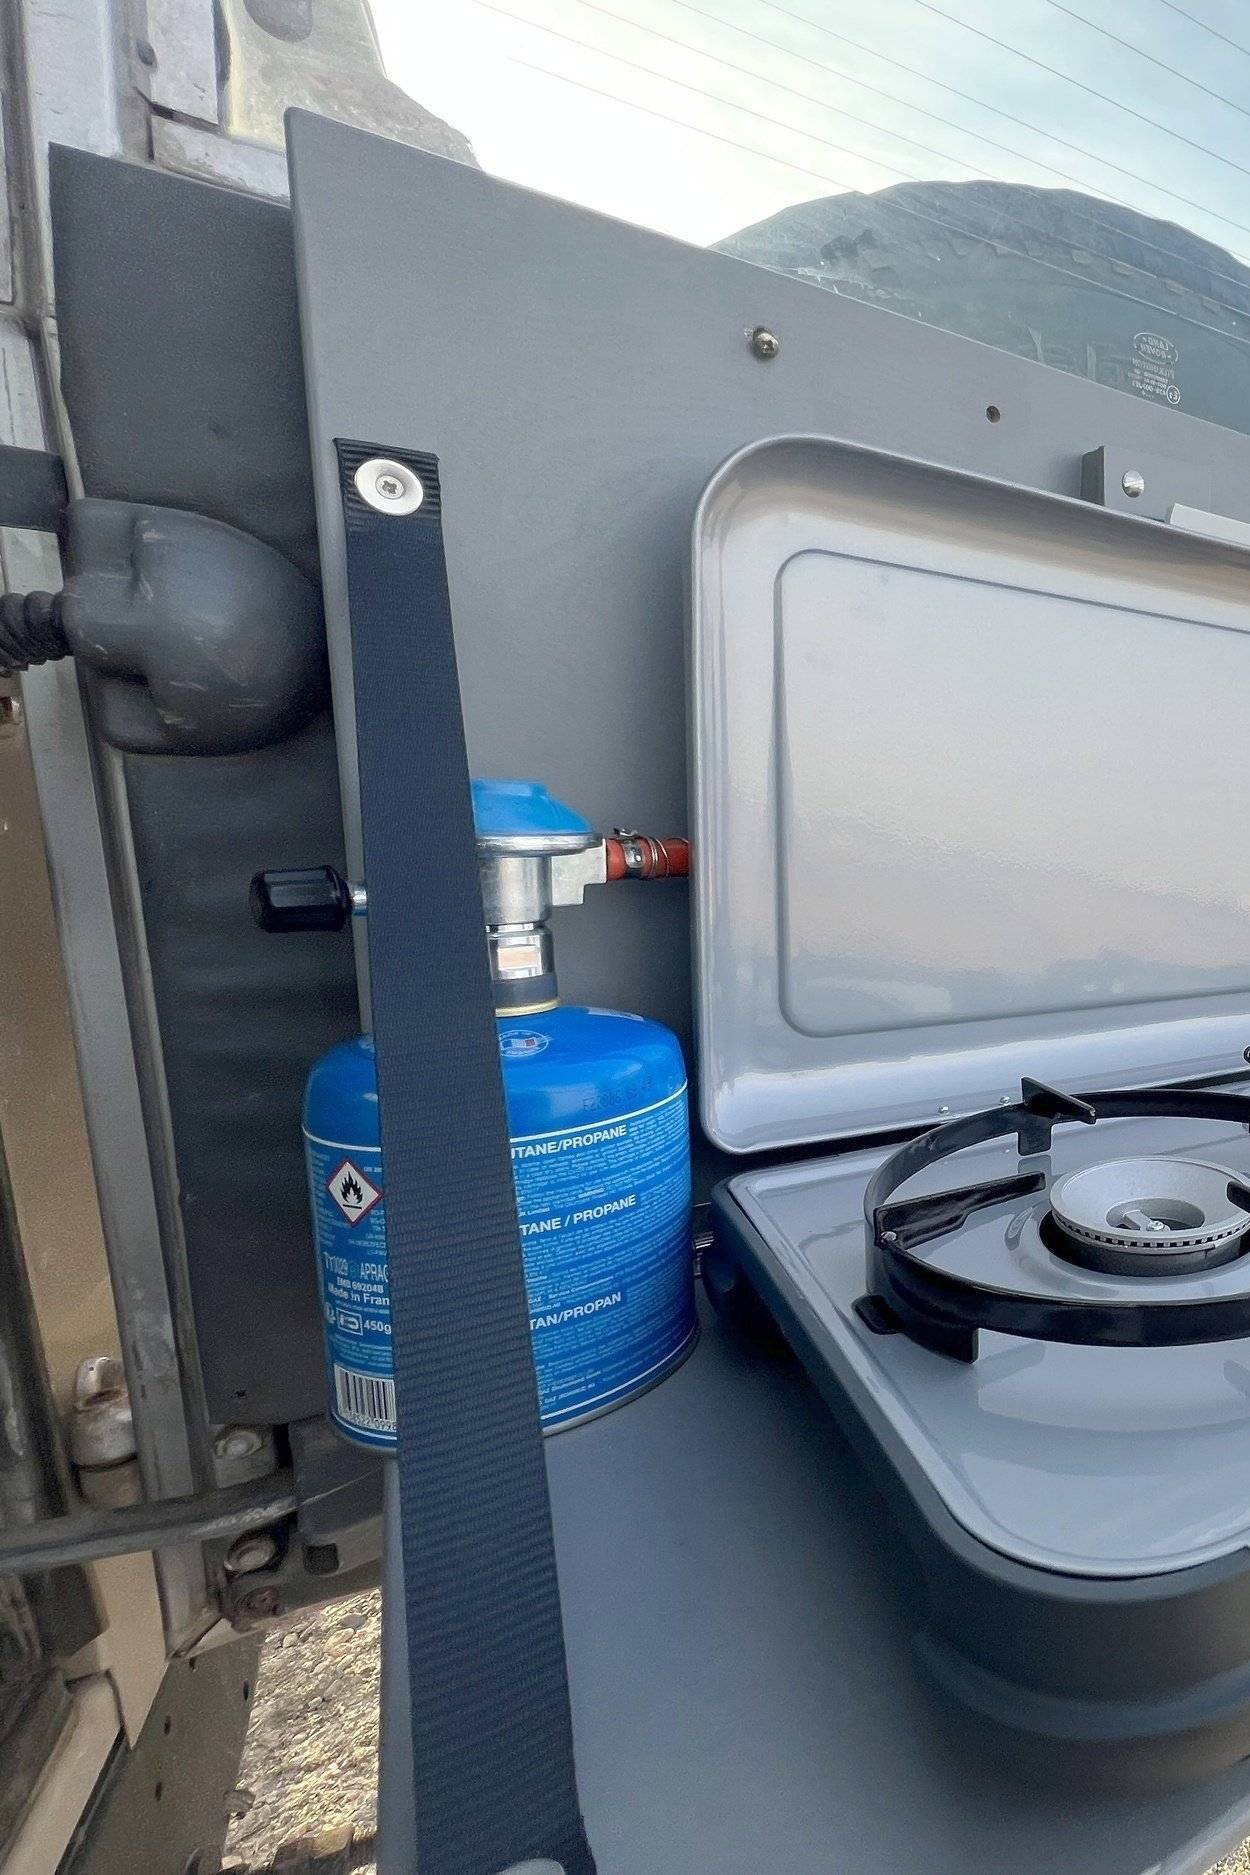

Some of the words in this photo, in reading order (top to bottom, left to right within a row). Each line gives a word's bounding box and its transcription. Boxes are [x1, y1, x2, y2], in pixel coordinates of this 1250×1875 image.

[510, 1124, 627, 1160] TANE/PROPANE
[573, 1194, 637, 1225] PROPANE
[350, 1290, 361, 1302] in
